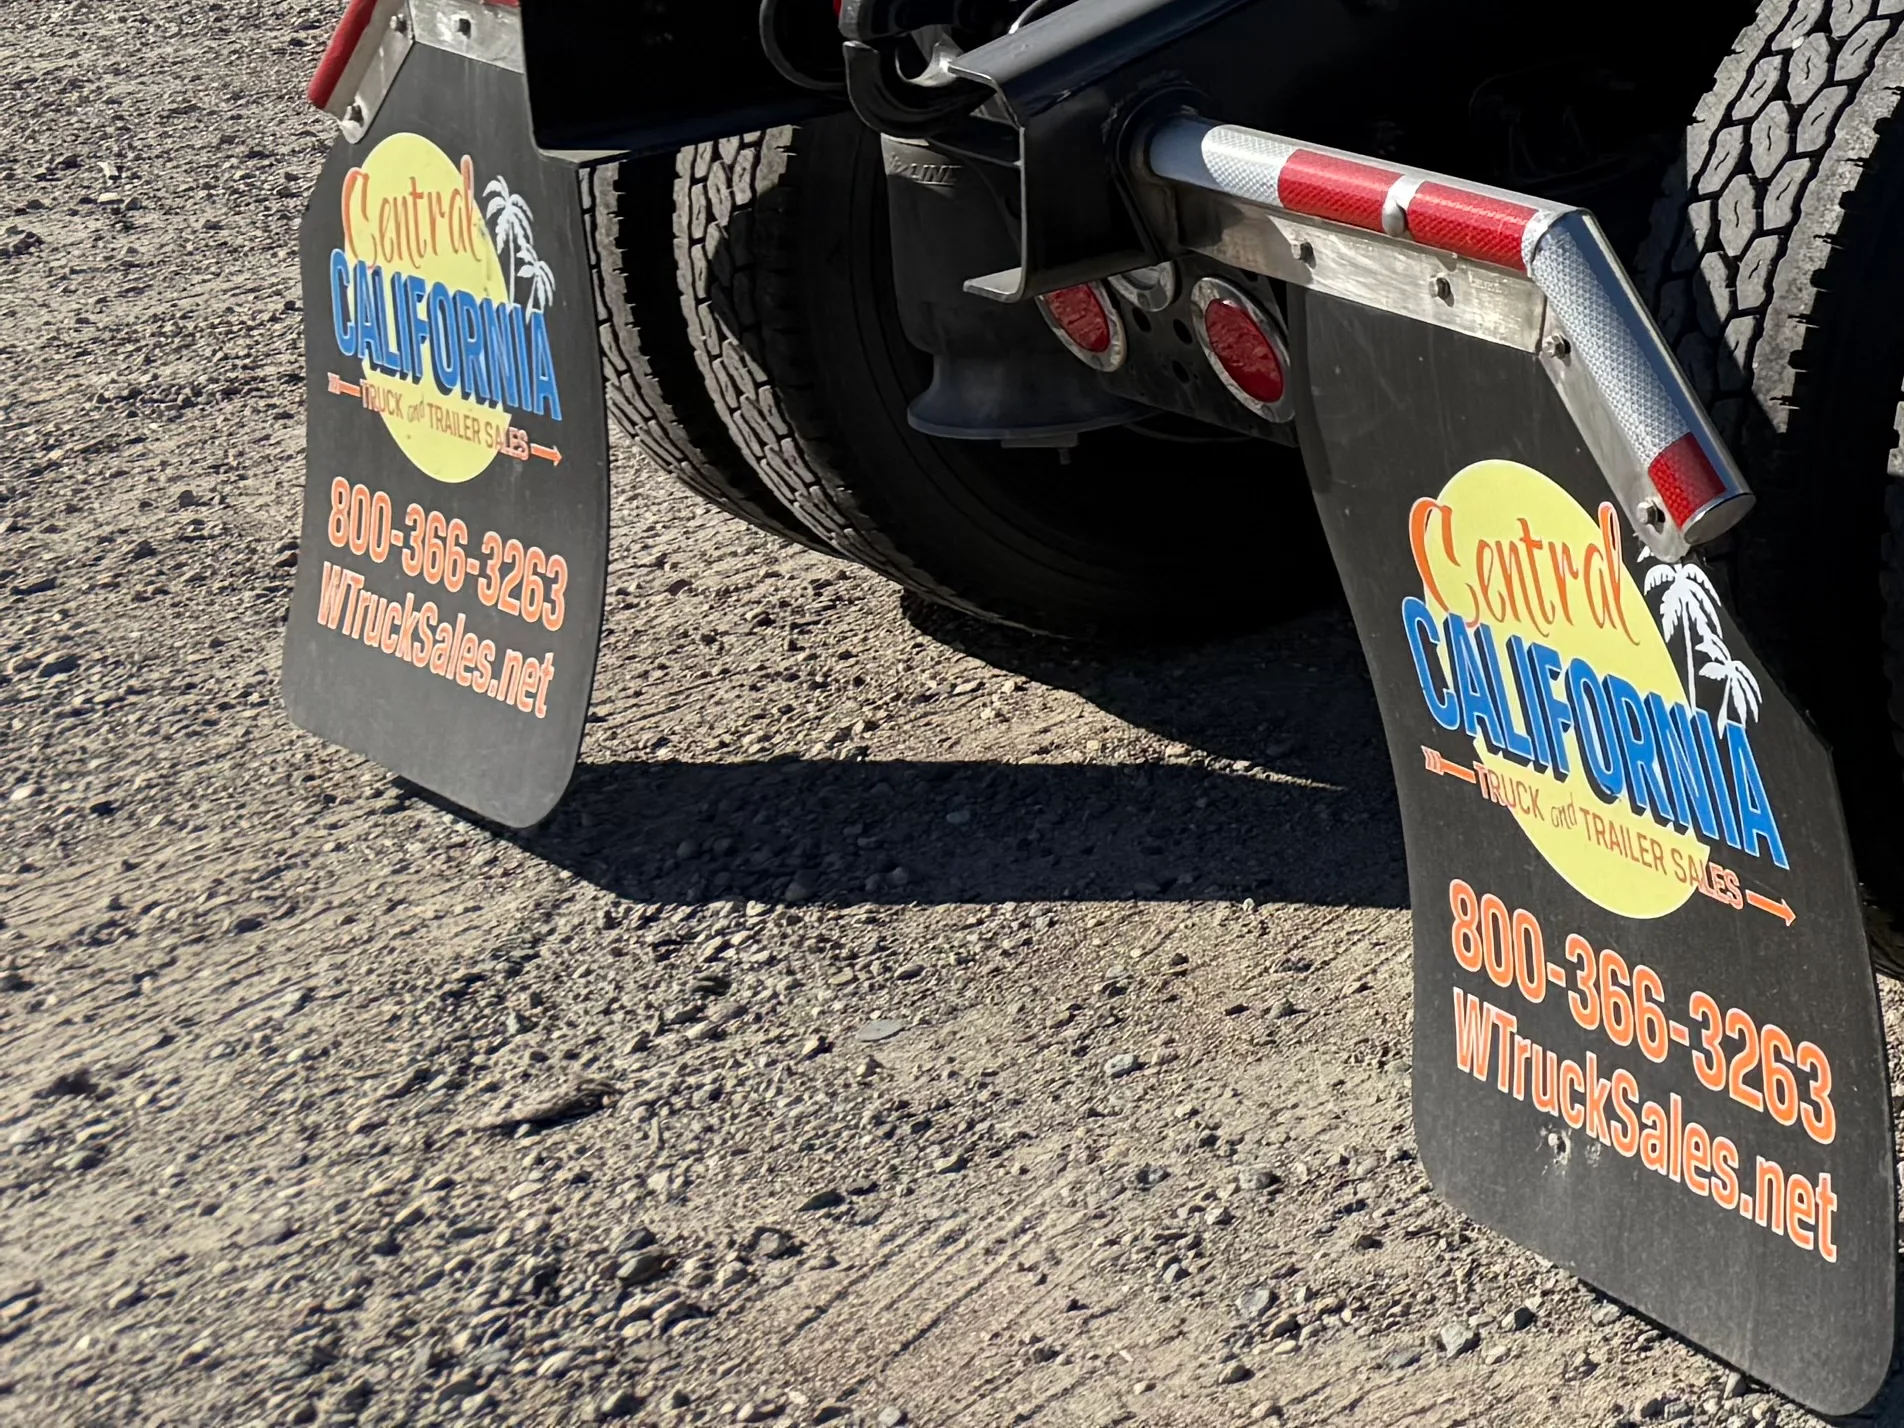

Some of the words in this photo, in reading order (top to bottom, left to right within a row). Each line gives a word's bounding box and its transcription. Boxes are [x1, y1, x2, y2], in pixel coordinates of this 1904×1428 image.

[342, 154, 481, 268] Central
[329, 248, 562, 421] CALIFORNIA
[361, 380, 404, 422] TRUCK
[406, 399, 425, 425] and
[427, 404, 483, 446] TRAILER
[483, 423, 530, 461] SALES
[328, 476, 568, 632] 800-366-3263
[1409, 496, 1641, 646] Central
[317, 560, 555, 719] WTruckSales.net
[1402, 596, 1790, 871] CALIFORNIA
[1474, 761, 1544, 821] TRUCK
[1550, 796, 1579, 832] and
[1581, 807, 1667, 875] TRAILER
[1668, 844, 1744, 911] SALES
[1449, 878, 1837, 1146] 800-366-3263
[1453, 987, 1839, 1264] WTruckSales.net
